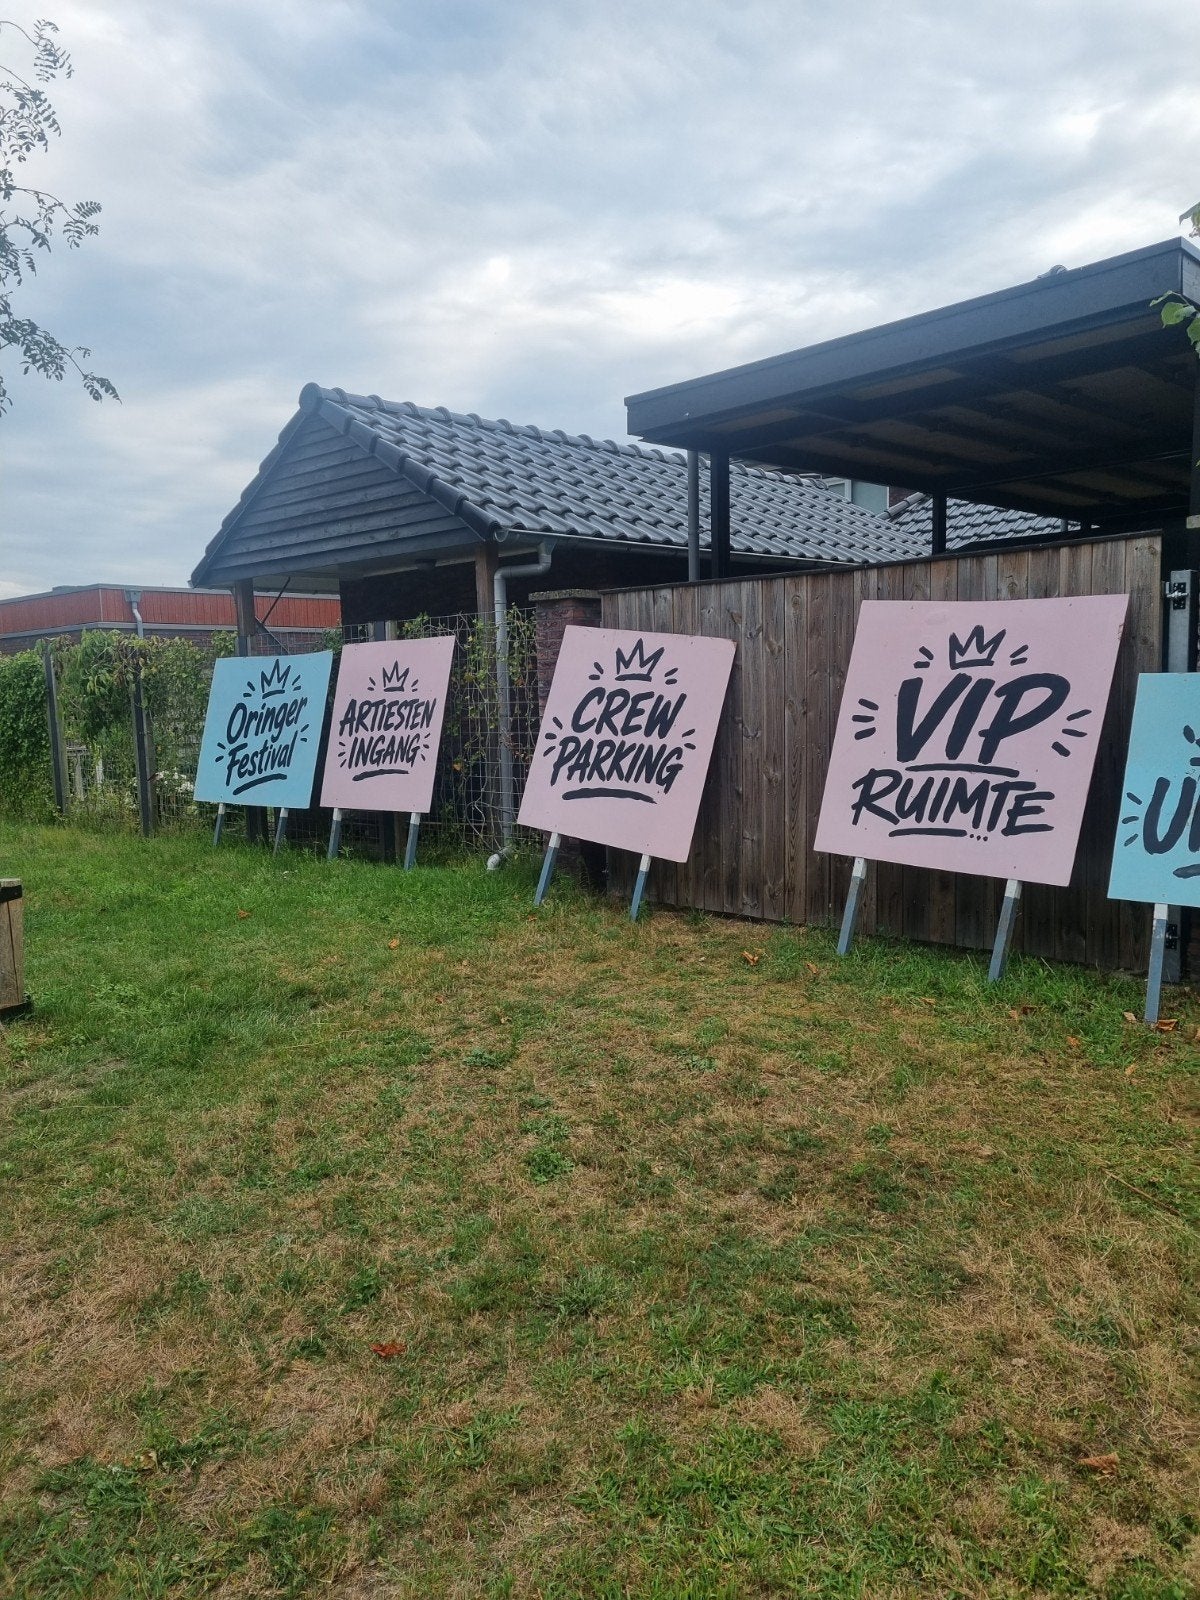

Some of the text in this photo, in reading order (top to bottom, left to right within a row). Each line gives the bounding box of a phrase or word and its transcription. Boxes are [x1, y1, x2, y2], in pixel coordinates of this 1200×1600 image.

[226, 696, 308, 744] Oringer
[339, 698, 438, 737] ARTIESTEN
[571, 686, 687, 740] CREW
[896, 673, 1071, 765] VIP
[225, 731, 298, 786] Festival
[347, 733, 421, 769] INGANG
[550, 736, 684, 795] PARKING
[851, 768, 1056, 837] RUIMTE
